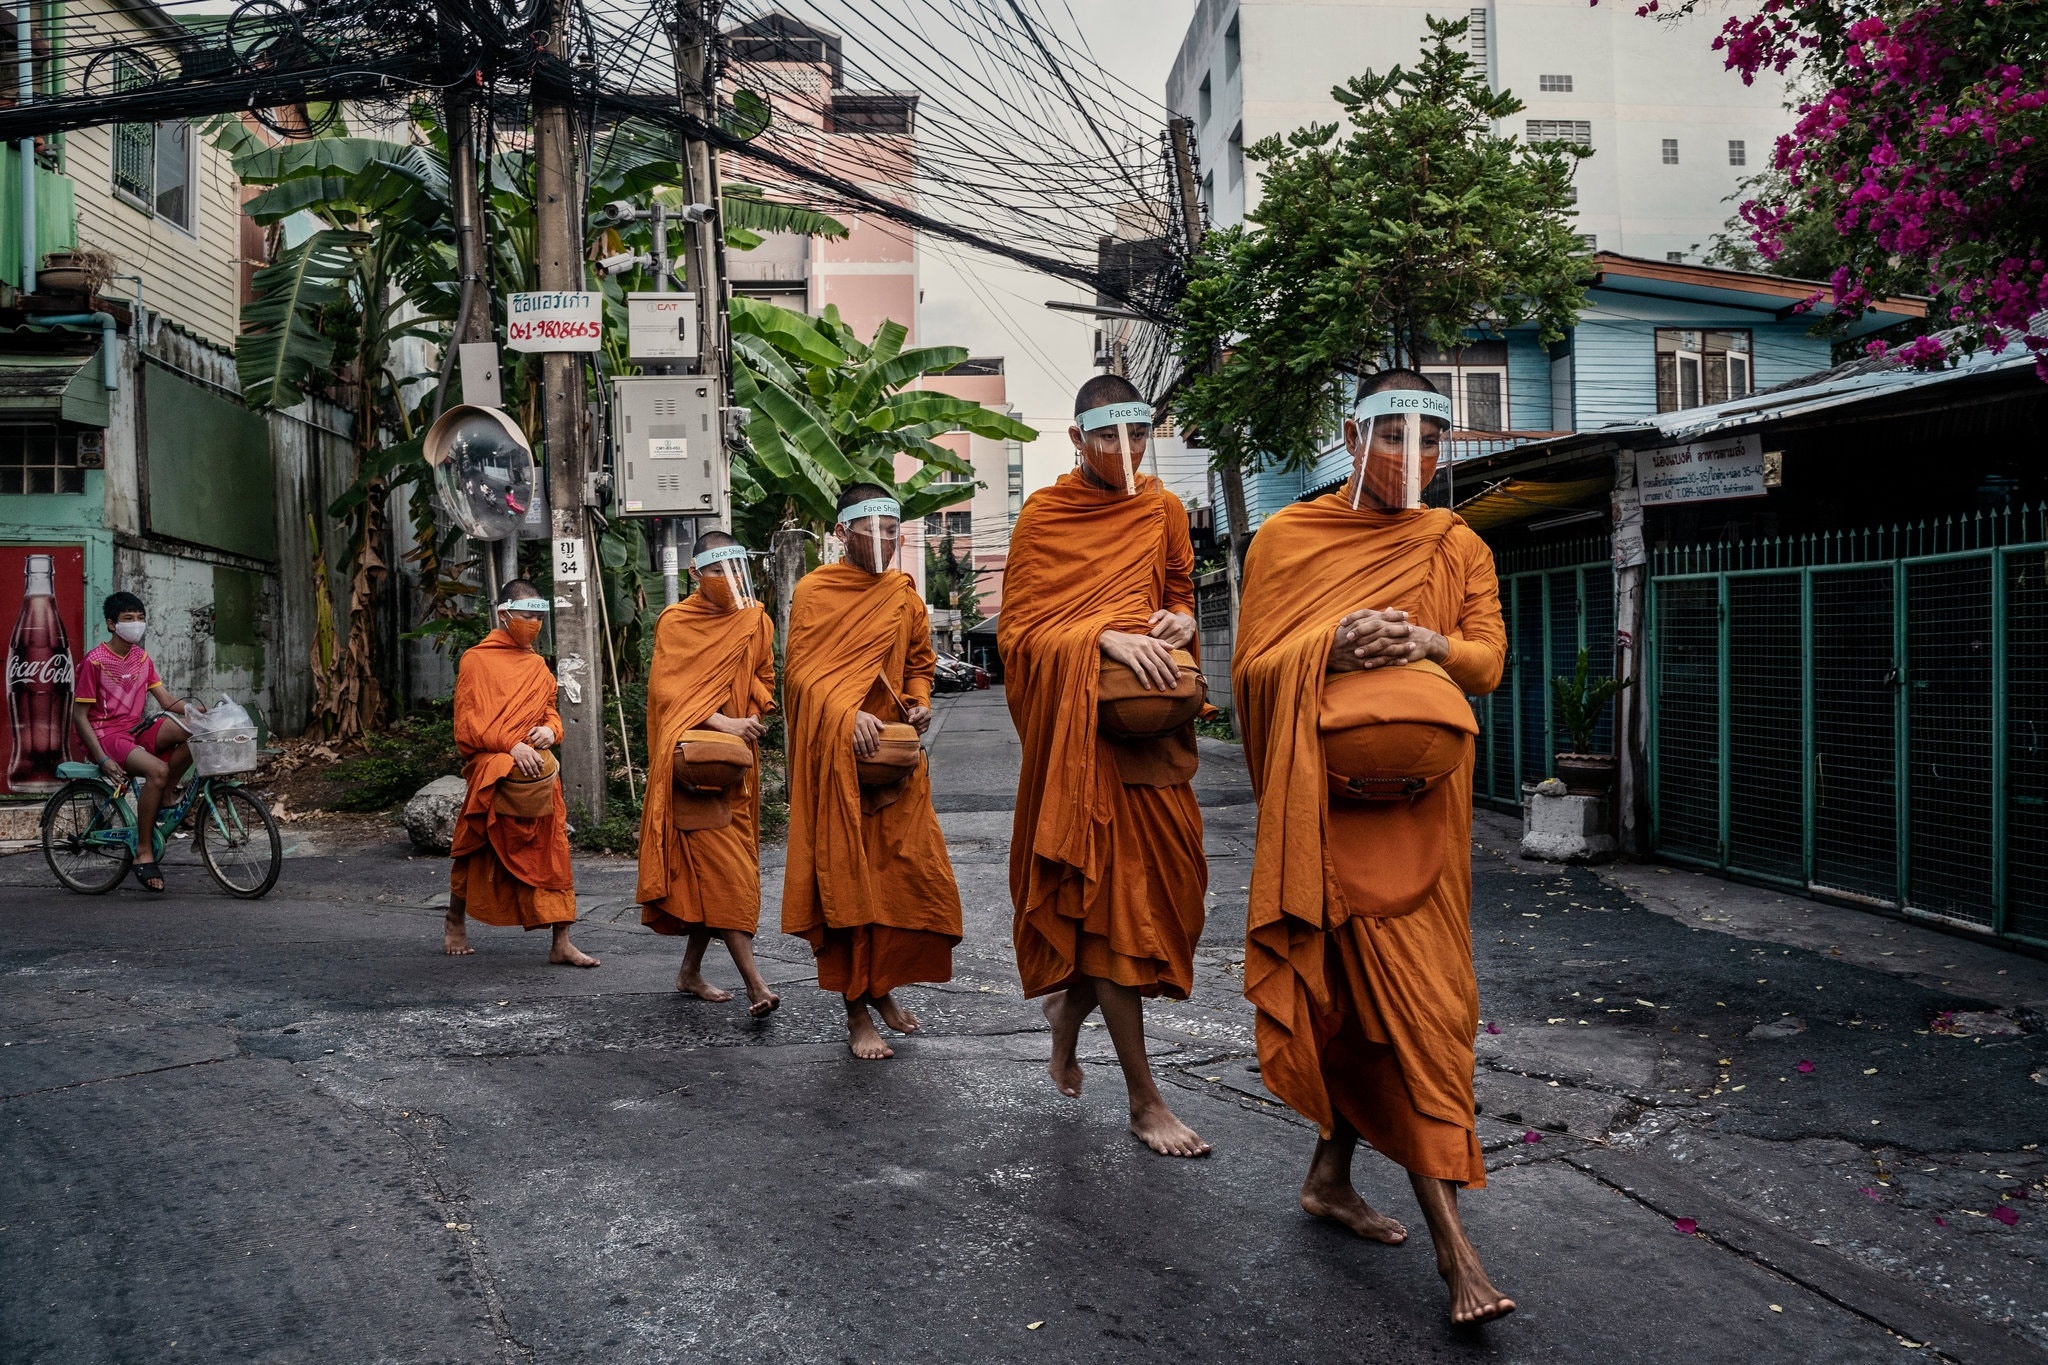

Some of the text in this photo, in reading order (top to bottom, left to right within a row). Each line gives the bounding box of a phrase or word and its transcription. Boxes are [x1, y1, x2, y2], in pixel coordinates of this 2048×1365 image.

[1390, 396, 1419, 408] Face
[1109, 409, 1132, 418] Face
[1697, 438, 1746, 462] อาหารตามสั่ง
[863, 504, 882, 513] Face
[711, 550, 728, 559] Face
[561, 561, 578, 574] 34
